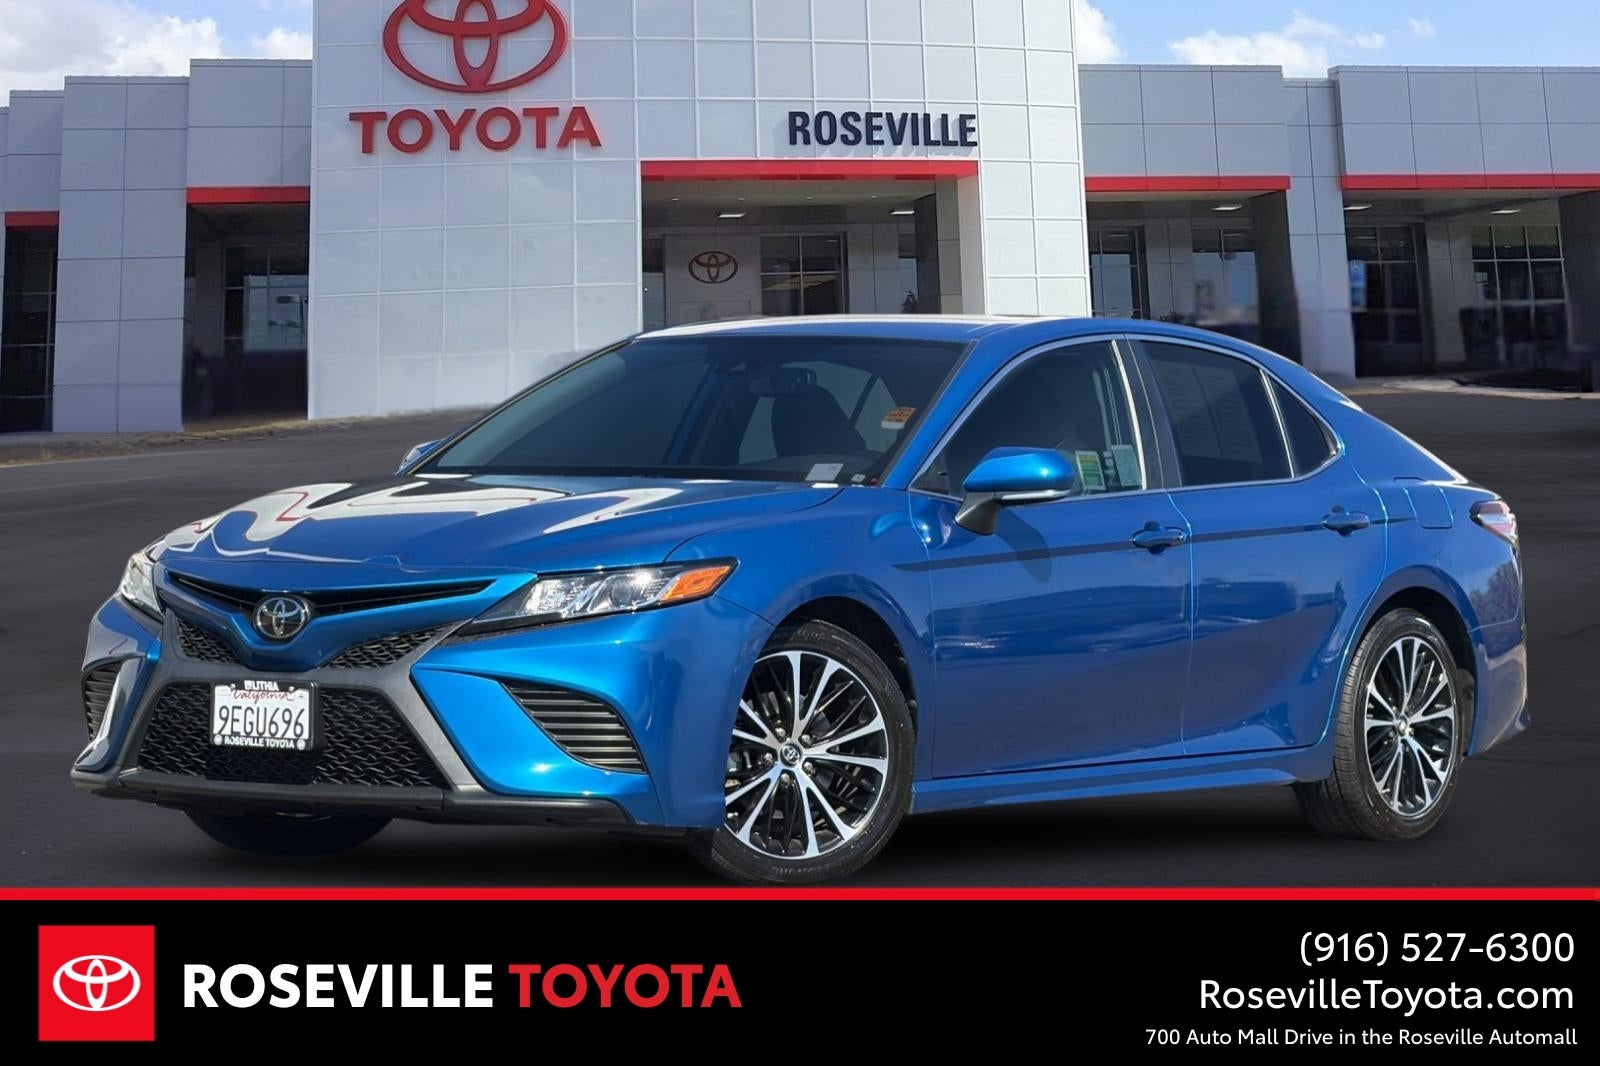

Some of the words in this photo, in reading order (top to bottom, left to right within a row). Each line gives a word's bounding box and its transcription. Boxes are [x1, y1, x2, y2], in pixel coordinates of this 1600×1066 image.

[349, 106, 602, 154] TOYOTA
[788, 111, 978, 147] ROSEVILLE
[232, 690, 289, 704] California
[252, 681, 279, 691] LITHIA
[218, 705, 304, 738] 9EGU696
[225, 736, 264, 747] ROSEVILLE
[266, 738, 295, 749] TOYOTA
